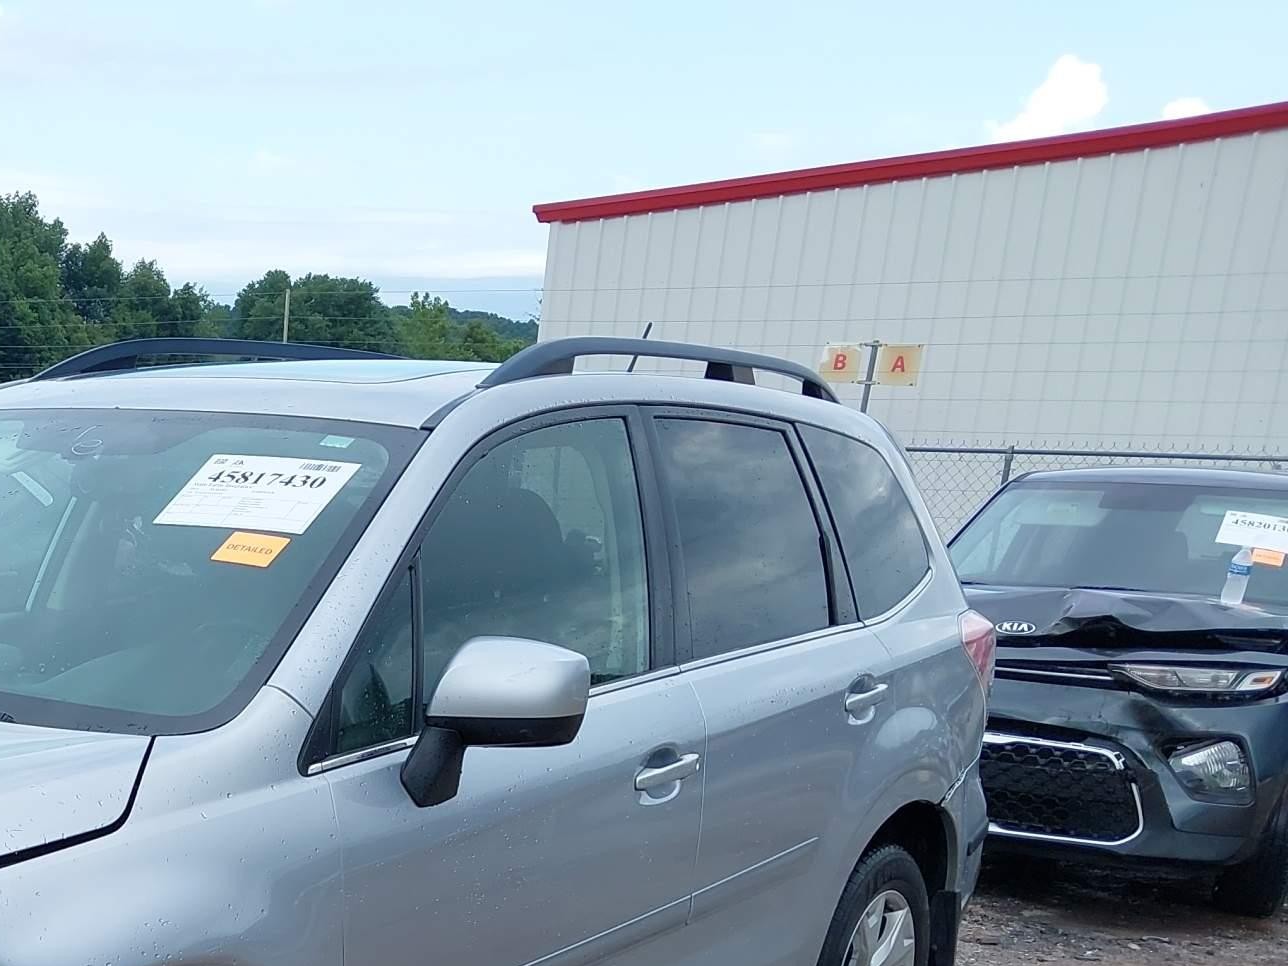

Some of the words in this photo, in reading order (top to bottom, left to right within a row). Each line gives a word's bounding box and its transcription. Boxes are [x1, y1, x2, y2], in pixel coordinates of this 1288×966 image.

[833, 353, 847, 370] B
[891, 355, 905, 372] A
[208, 470, 327, 489] 45817430
[226, 543, 273, 555] DETAILED
[1002, 622, 1029, 631] KIA
